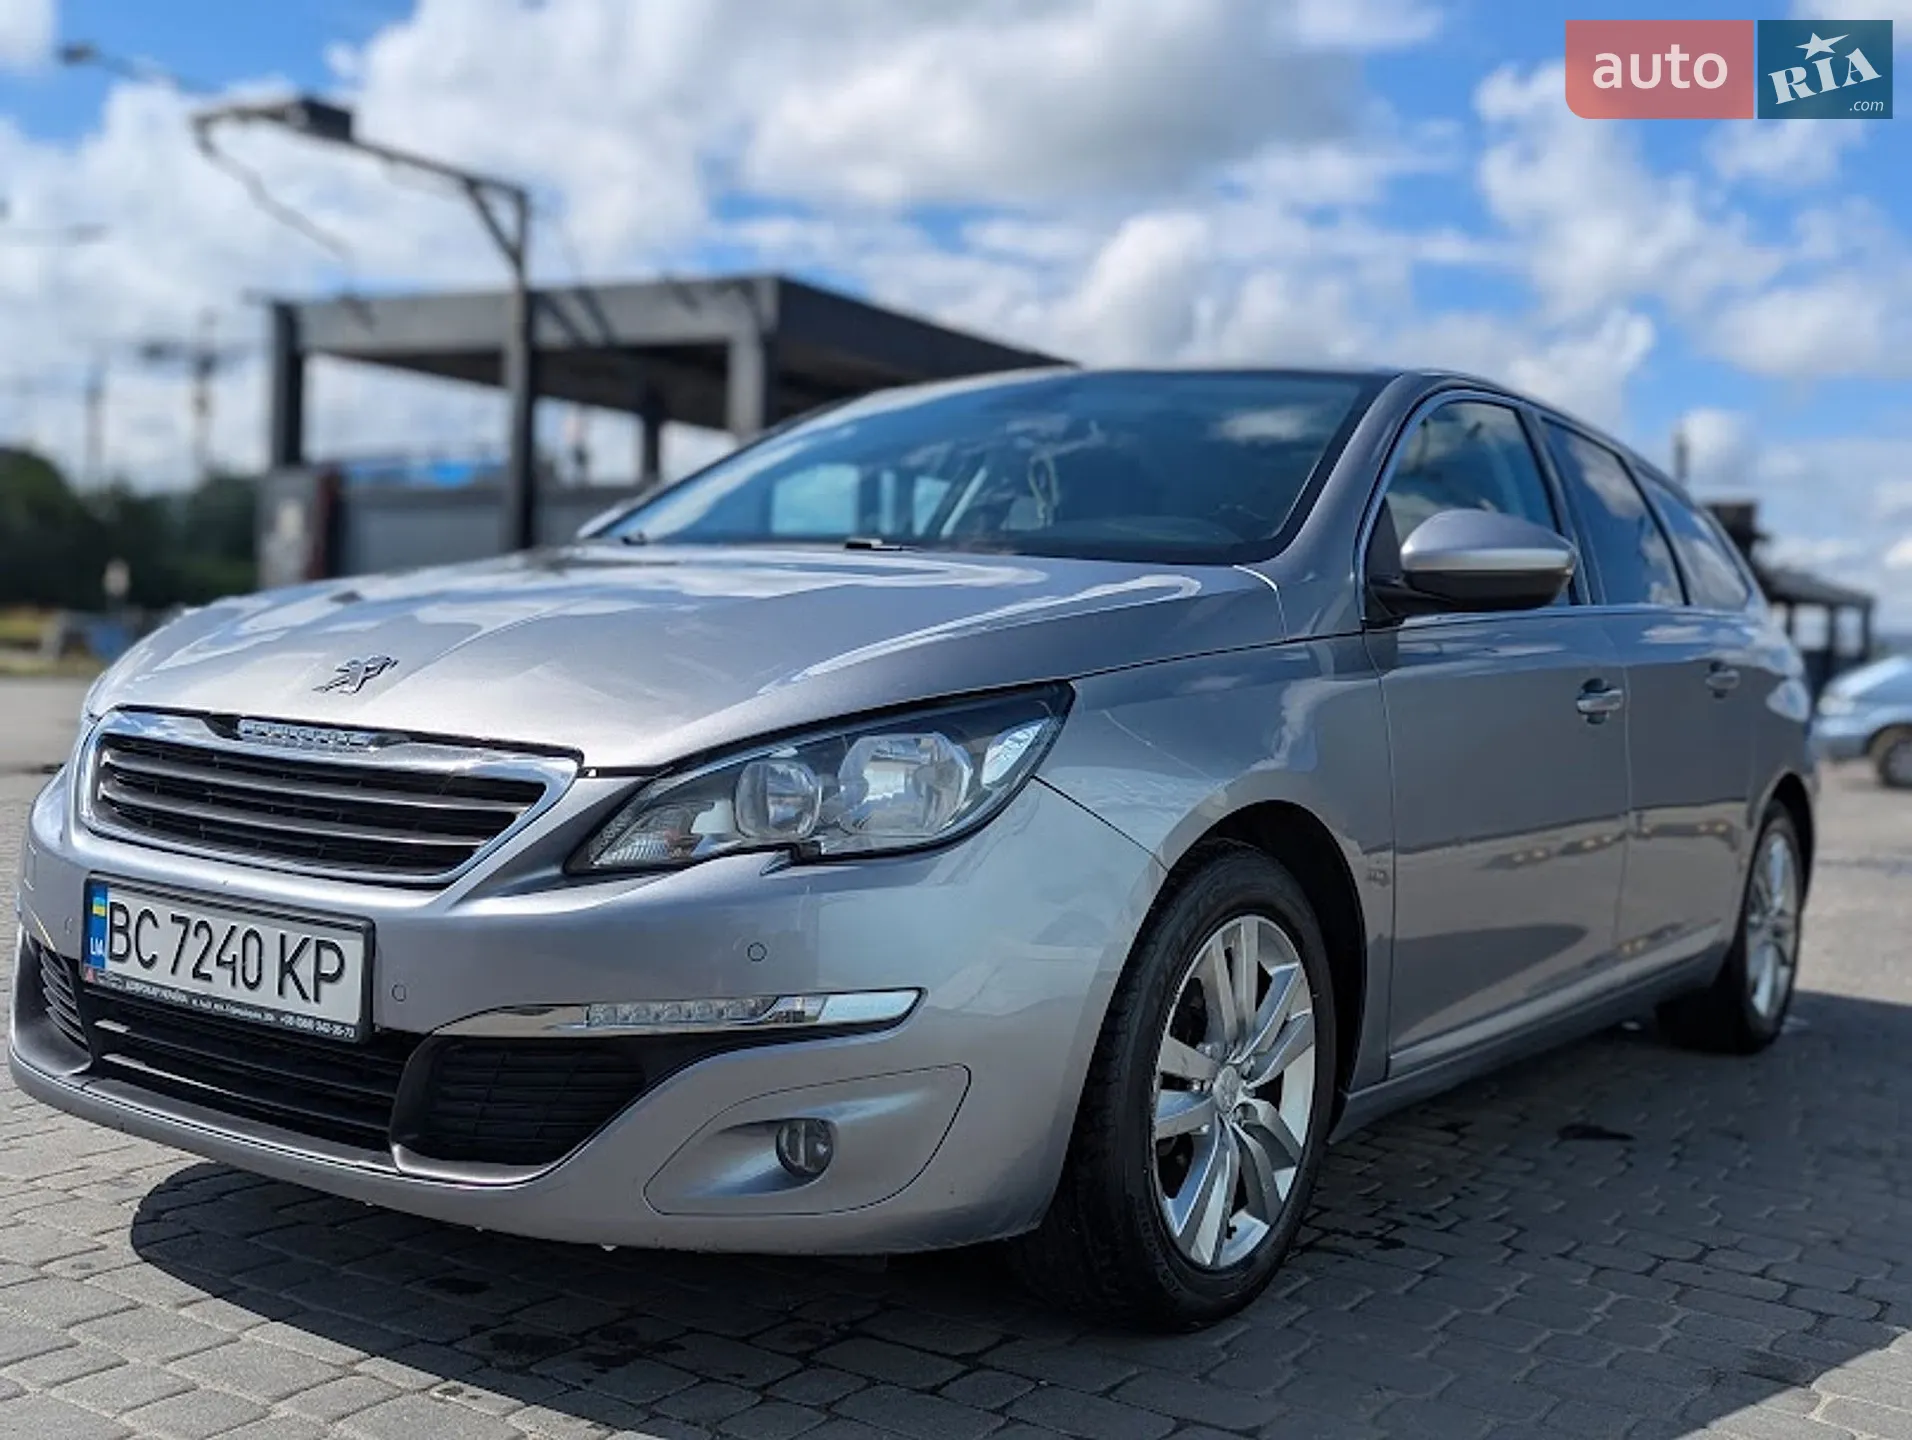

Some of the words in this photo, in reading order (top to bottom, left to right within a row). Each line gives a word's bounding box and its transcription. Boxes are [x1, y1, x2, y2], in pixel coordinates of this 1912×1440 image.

[108, 901, 159, 969] BC
[170, 913, 263, 991] 7240
[277, 932, 346, 1004] KP
